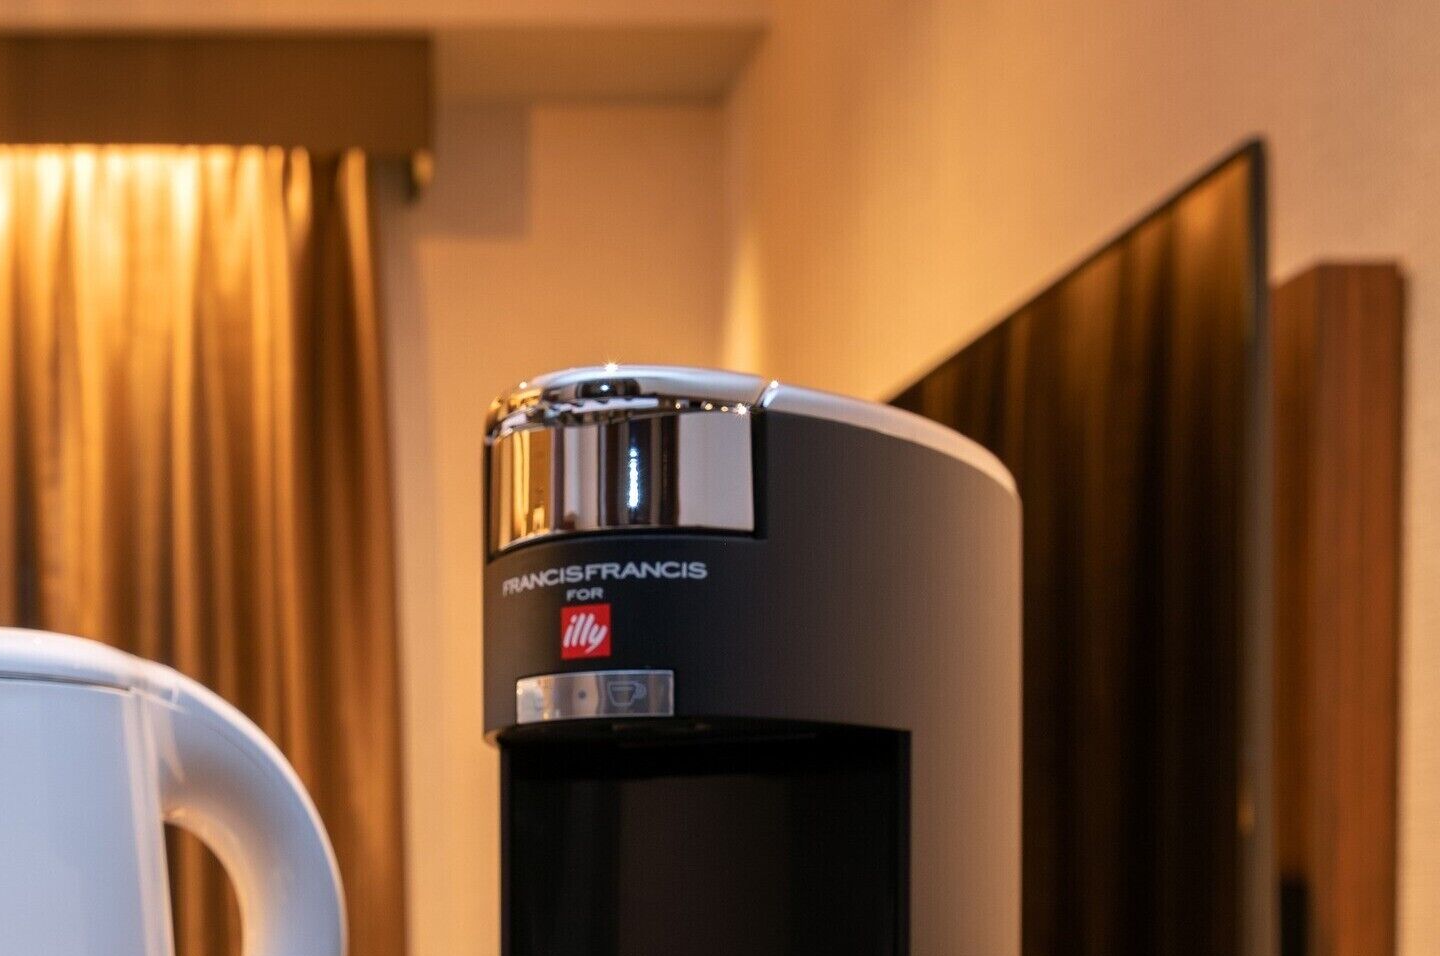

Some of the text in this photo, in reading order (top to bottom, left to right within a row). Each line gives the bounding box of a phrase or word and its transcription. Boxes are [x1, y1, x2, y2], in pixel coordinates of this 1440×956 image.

[502, 560, 709, 597] FRANCISFRANCIS
[566, 586, 604, 602] FOR
[562, 612, 609, 655] illy
